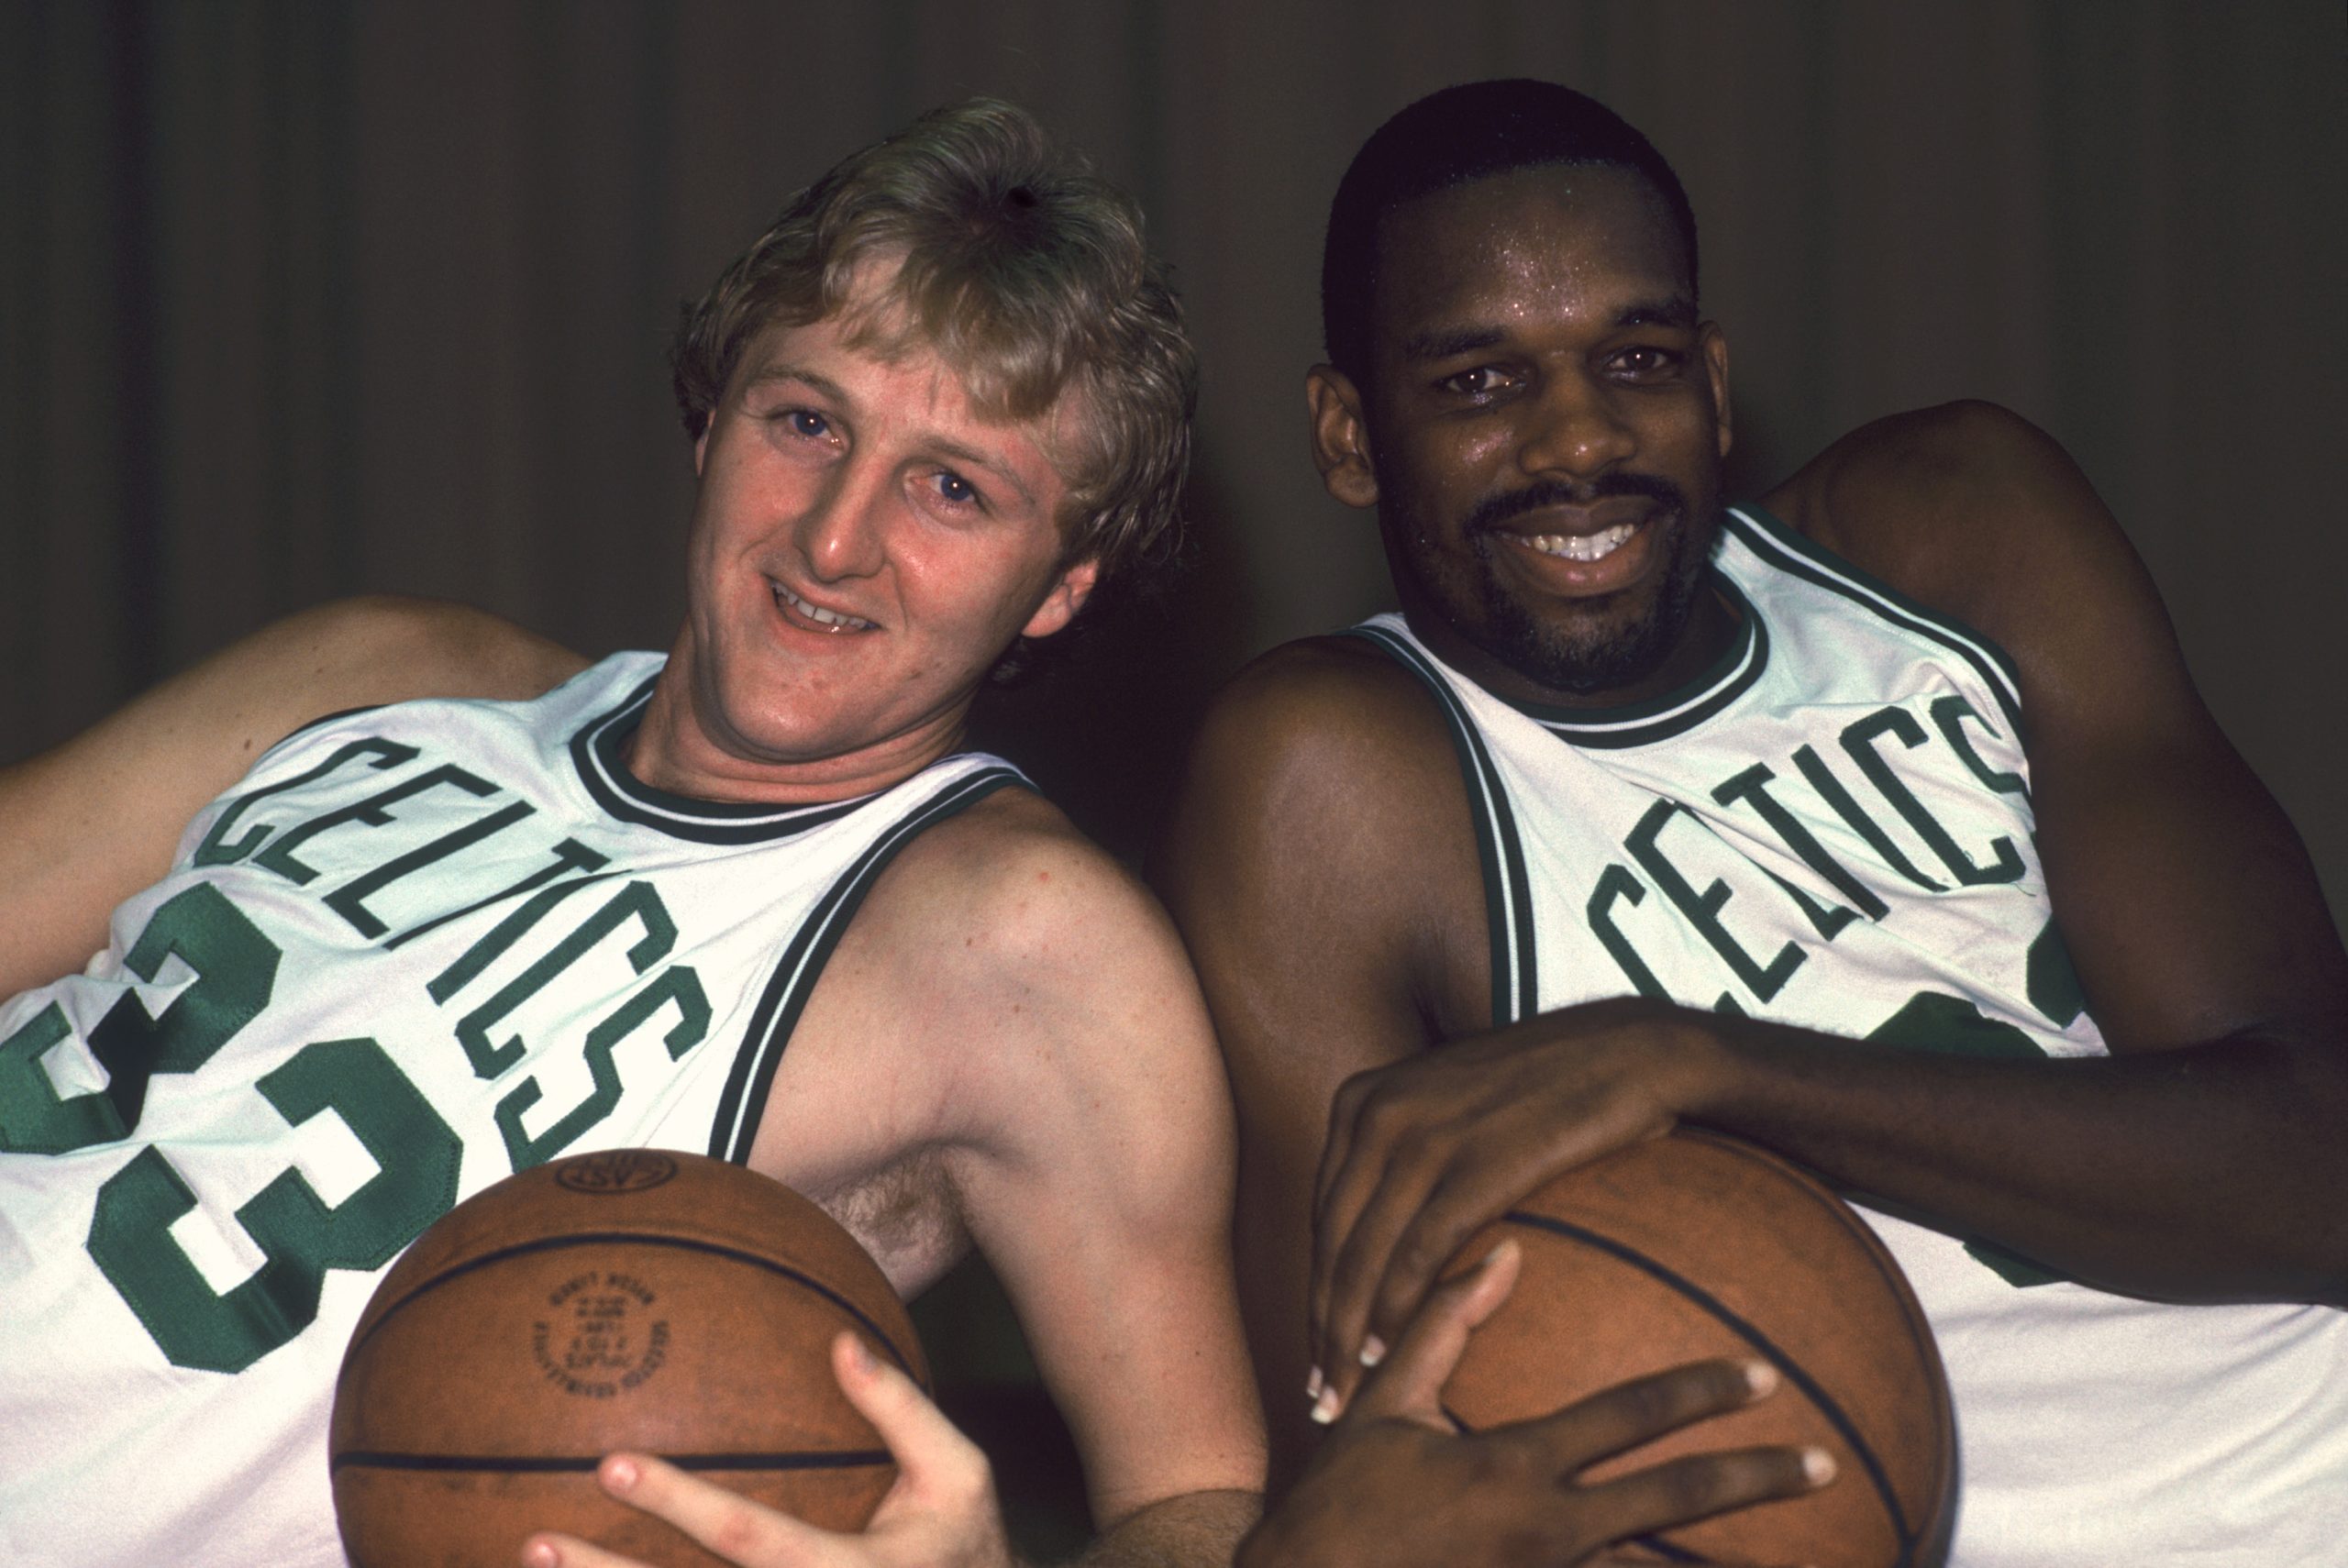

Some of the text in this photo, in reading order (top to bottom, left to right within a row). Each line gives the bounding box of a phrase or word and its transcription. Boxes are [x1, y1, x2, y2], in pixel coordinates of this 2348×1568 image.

[194, 736, 713, 1176] CELTICS
[1587, 694, 2035, 1018] CELTICS
[0, 880, 464, 1374] 33
